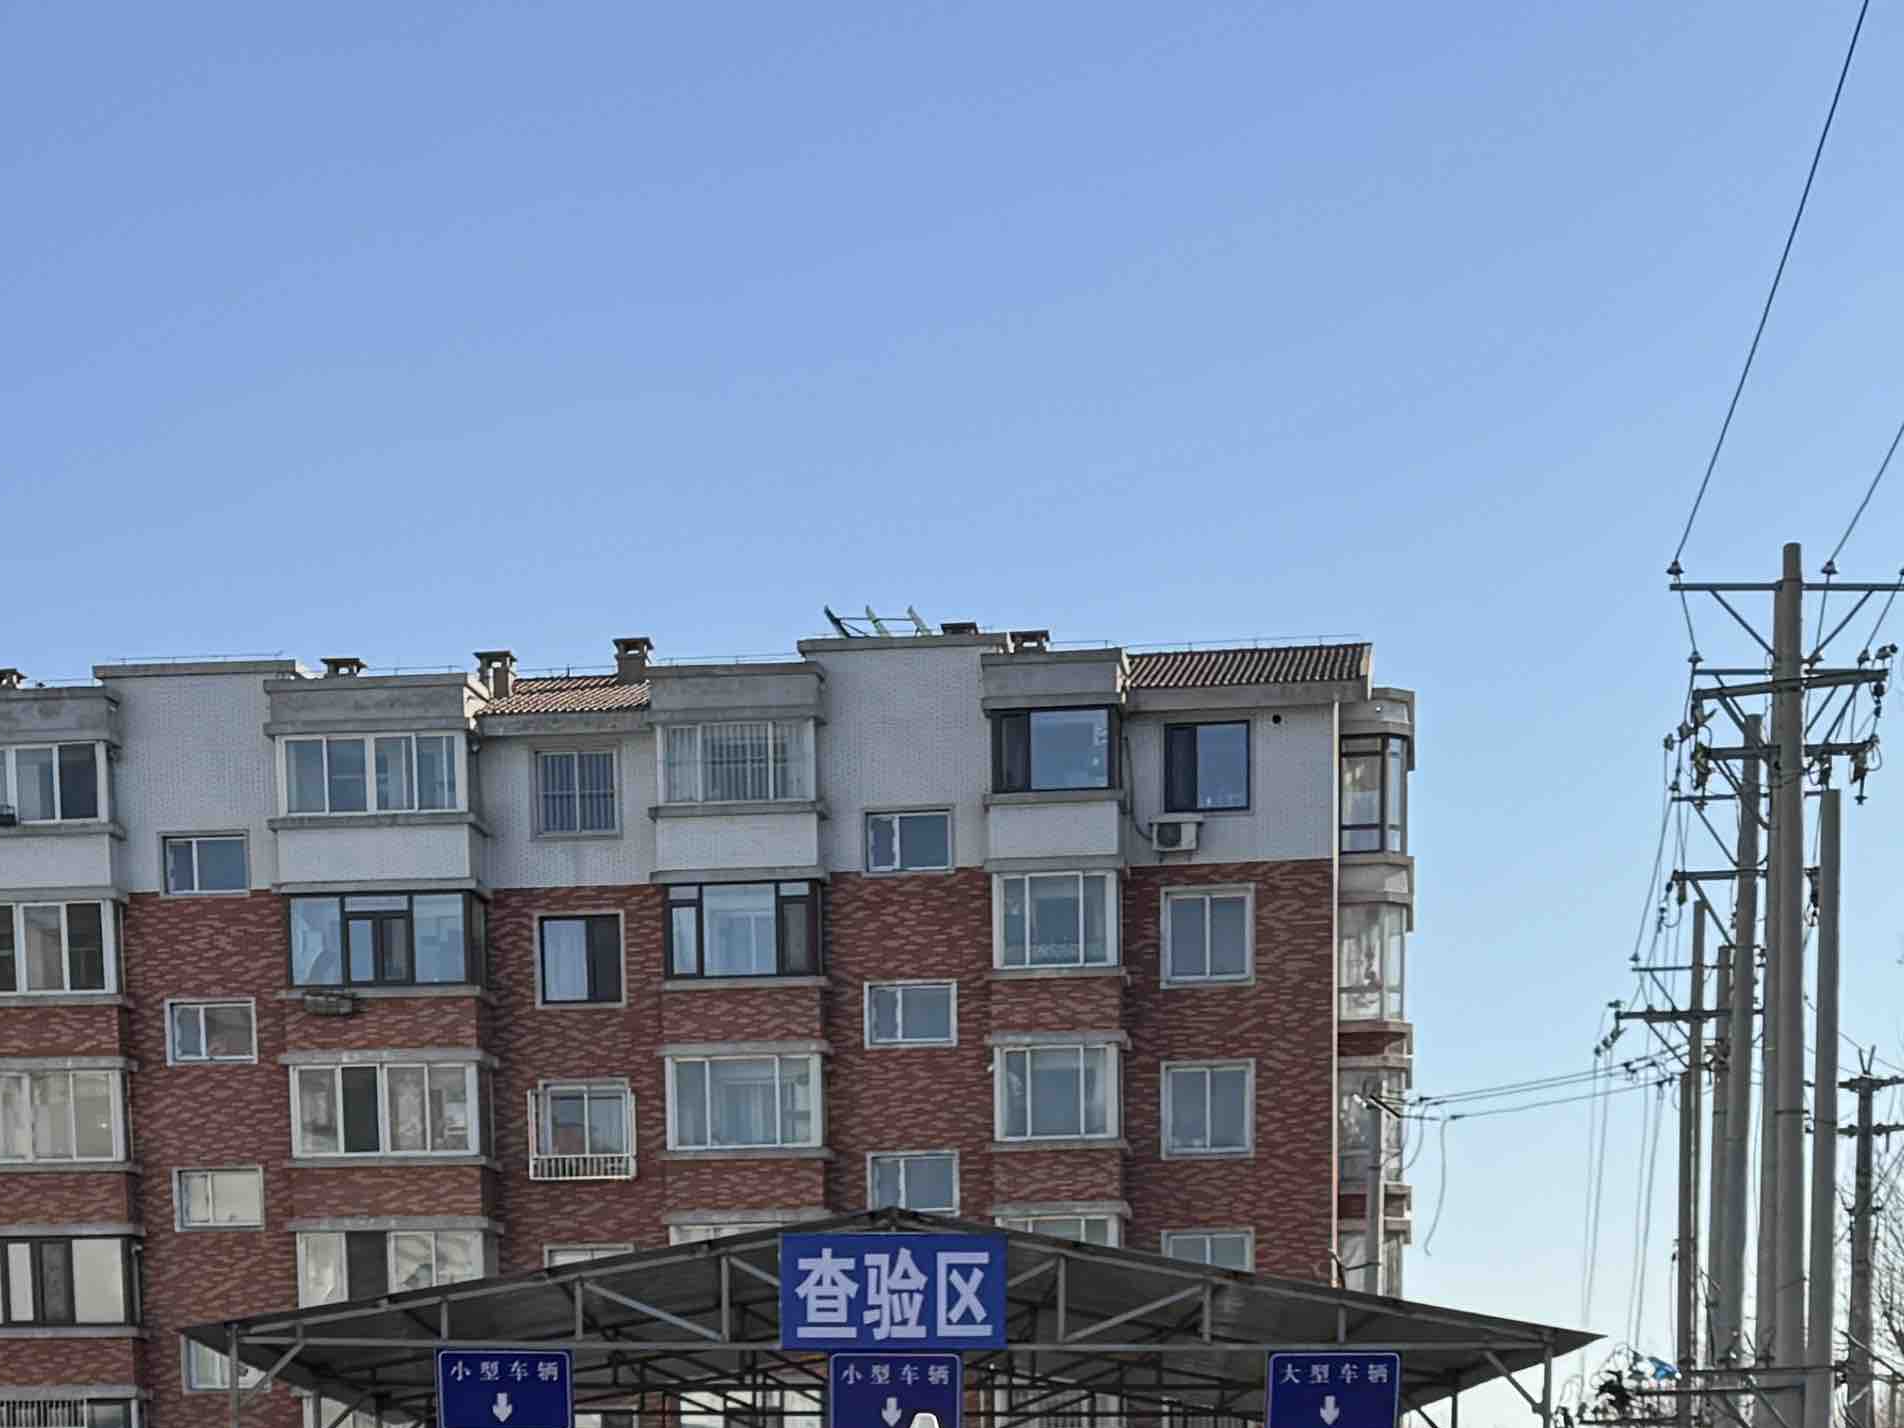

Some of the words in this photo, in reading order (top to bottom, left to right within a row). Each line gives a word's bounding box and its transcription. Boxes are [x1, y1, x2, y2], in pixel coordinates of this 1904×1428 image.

[795, 1248, 994, 1340] 查验区
[449, 1360, 560, 1382] 小型车辆
[840, 1364, 951, 1385] 小型车辆
[1280, 1363, 1389, 1385] 大型车辆
